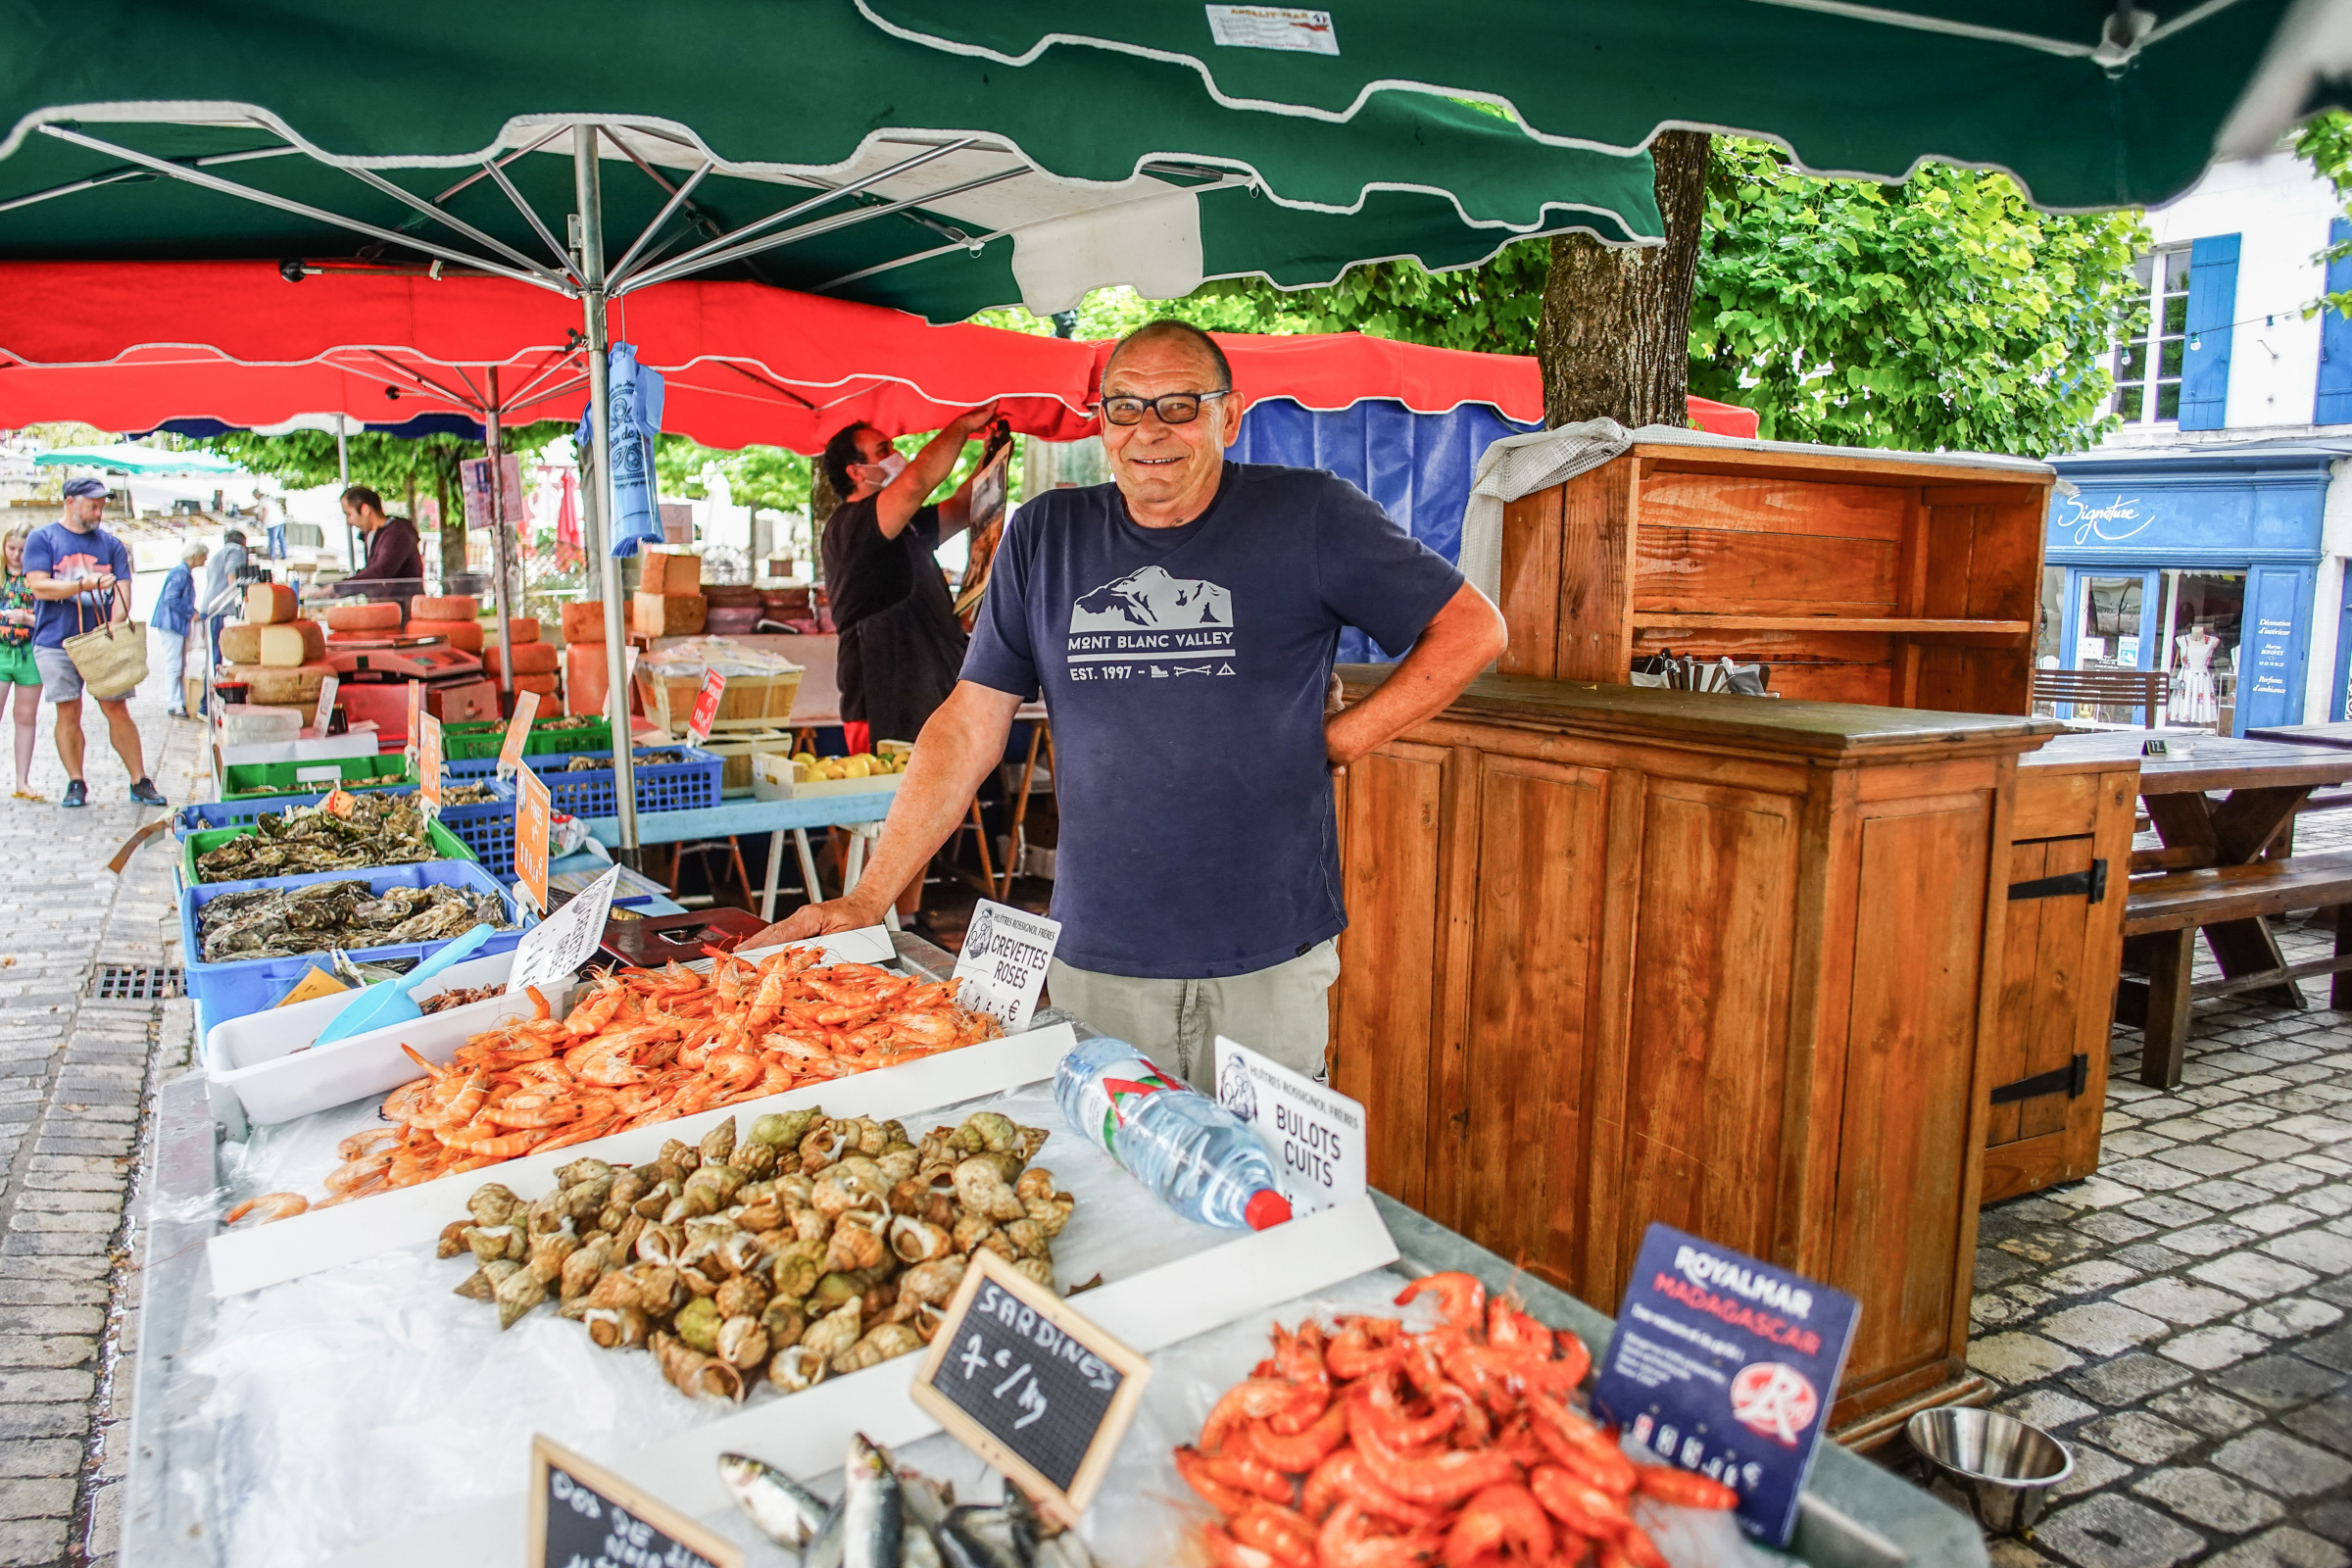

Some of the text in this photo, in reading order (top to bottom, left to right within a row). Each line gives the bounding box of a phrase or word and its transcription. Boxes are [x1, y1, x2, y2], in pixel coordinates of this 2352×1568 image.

[2058, 494, 2155, 545] Signature
[1067, 631, 1234, 651] MONT BLANC VALLEY
[2258, 627, 2291, 636] d'intérieur
[1069, 665, 1132, 680] EST. 1997
[2258, 675, 2282, 684] Parfums
[2252, 684, 2286, 694] d'ambiance
[2151, 742, 2164, 752] 12
[530, 798, 543, 827] FINES
[562, 907, 592, 975] CREVETTES
[993, 912, 1055, 941] HUÎTRES ROSSIGNOL FRÈRES
[547, 933, 570, 978] GRISES
[991, 934, 1049, 971] CREVETTES
[994, 960, 1029, 989] ROSES
[1008, 999, 1020, 1021] €
[1250, 1065, 1359, 1130] HUÎTRES ROSSIGNOL FRÈRES
[1276, 1103, 1341, 1160] BULOTS
[1284, 1140, 1334, 1188] CUITS
[1674, 1245, 1813, 1319] ROYALMAR
[1652, 1272, 1822, 1356] MADAGASCAR
